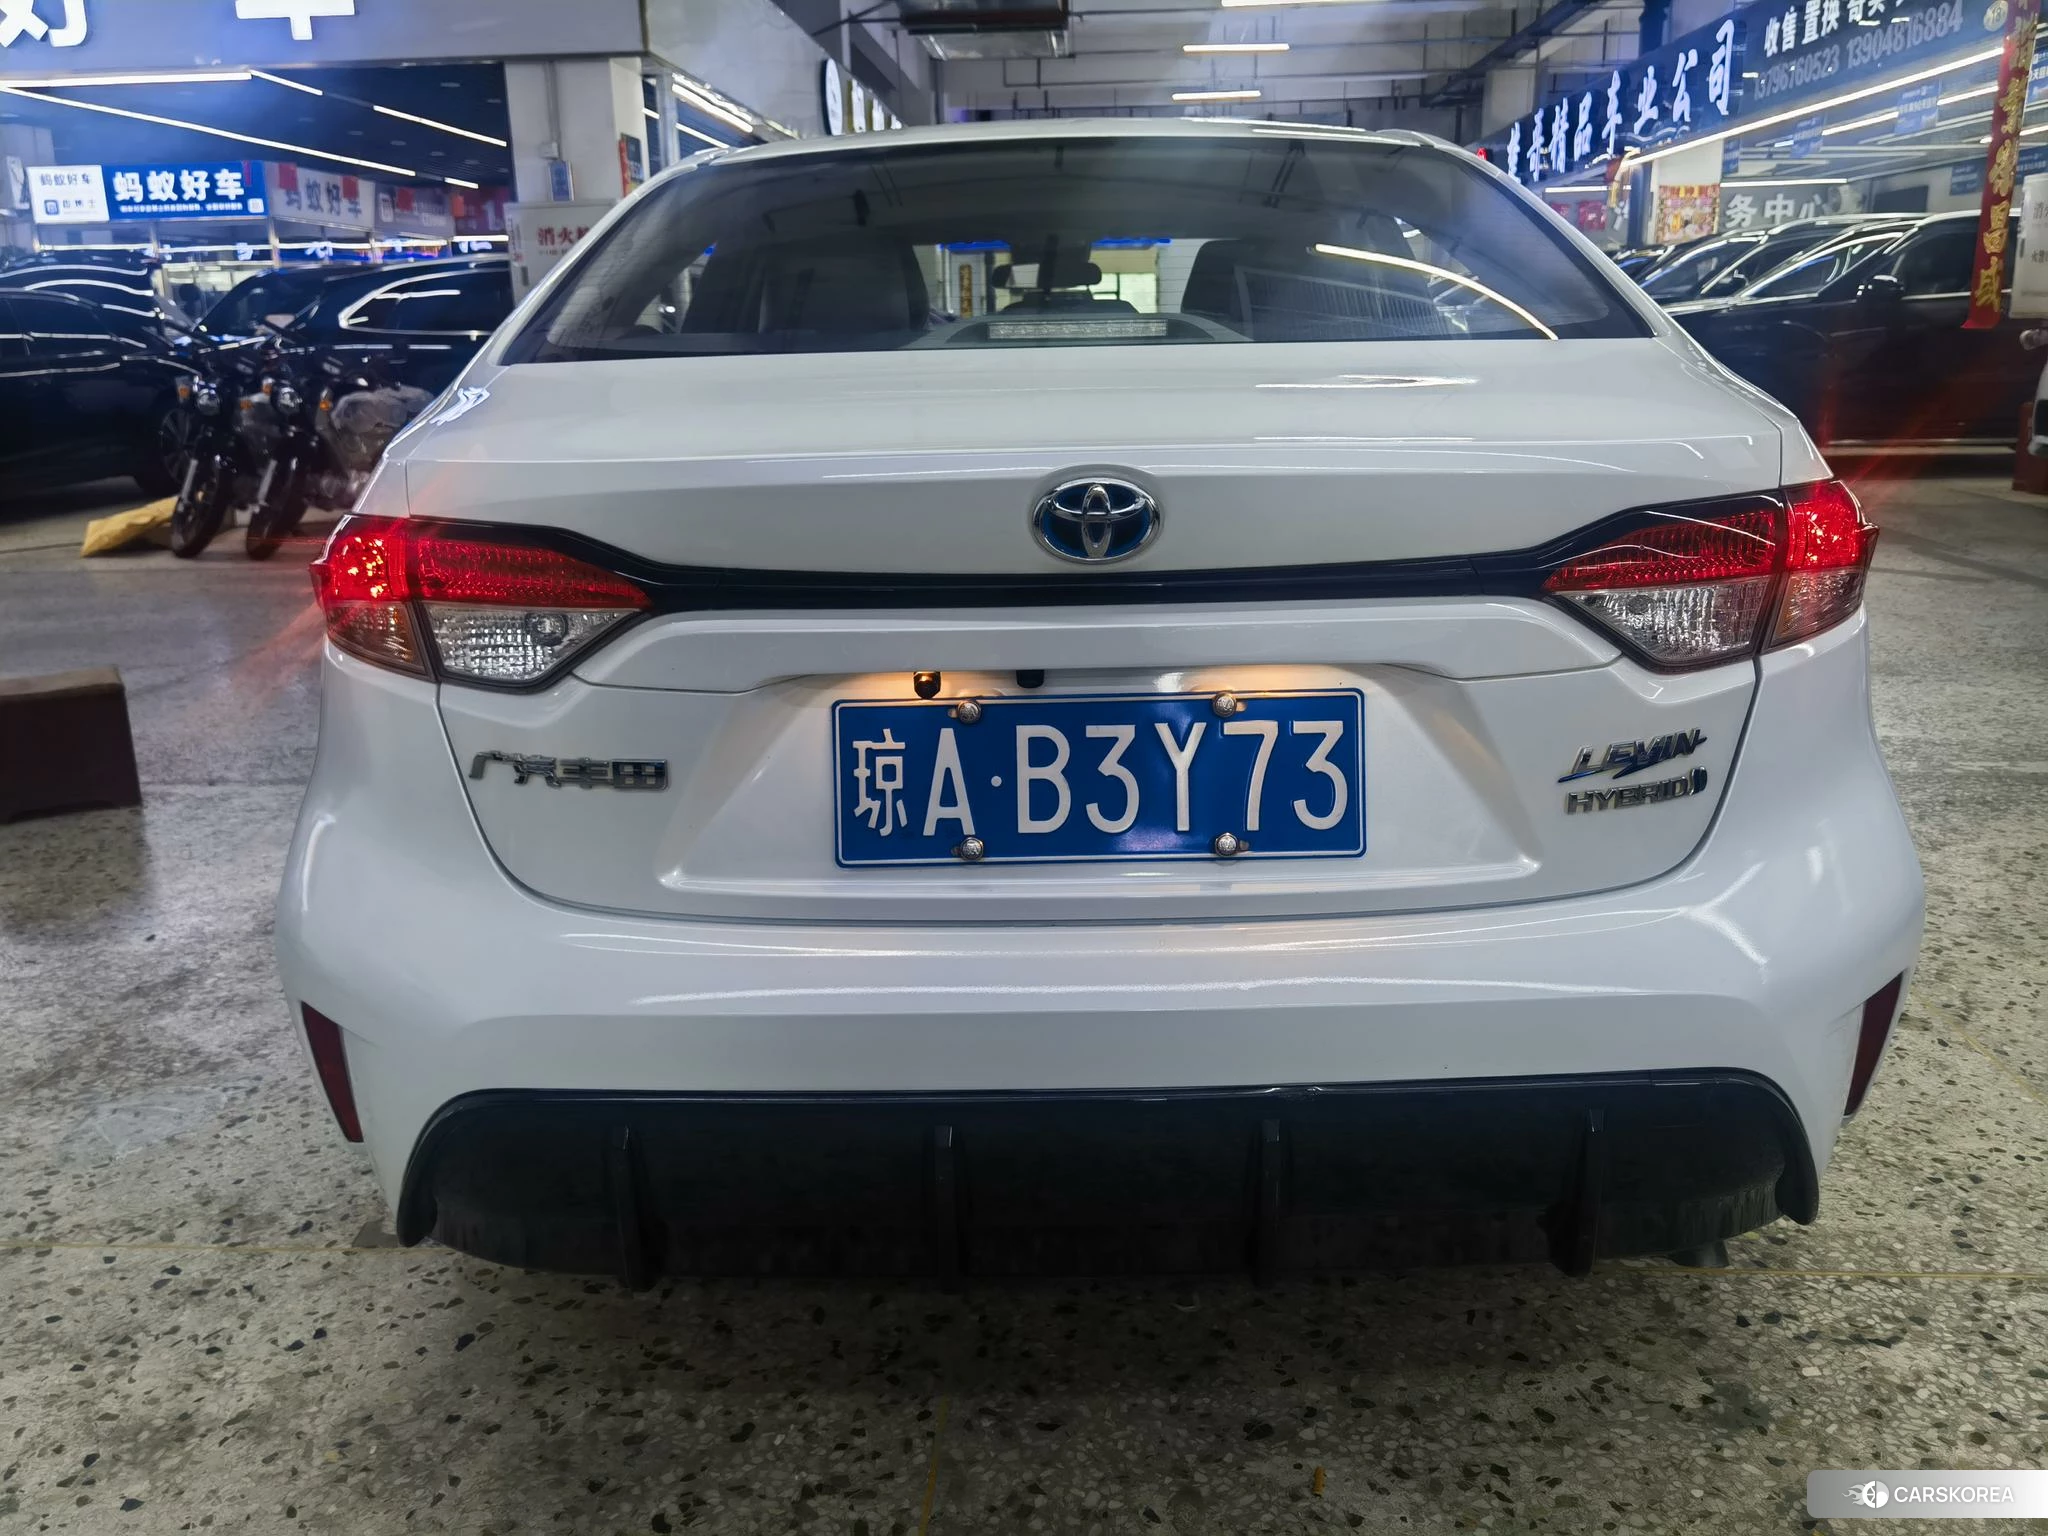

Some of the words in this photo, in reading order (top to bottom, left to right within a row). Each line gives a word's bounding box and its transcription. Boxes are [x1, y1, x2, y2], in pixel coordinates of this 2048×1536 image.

[1764, 6, 1798, 58] 收售
[112, 168, 244, 203] 蚂蚁好车
[469, 751, 669, 791] 广汽丰田
[1568, 727, 1707, 777] LEVIN
[1565, 776, 1689, 815] HYBRID
